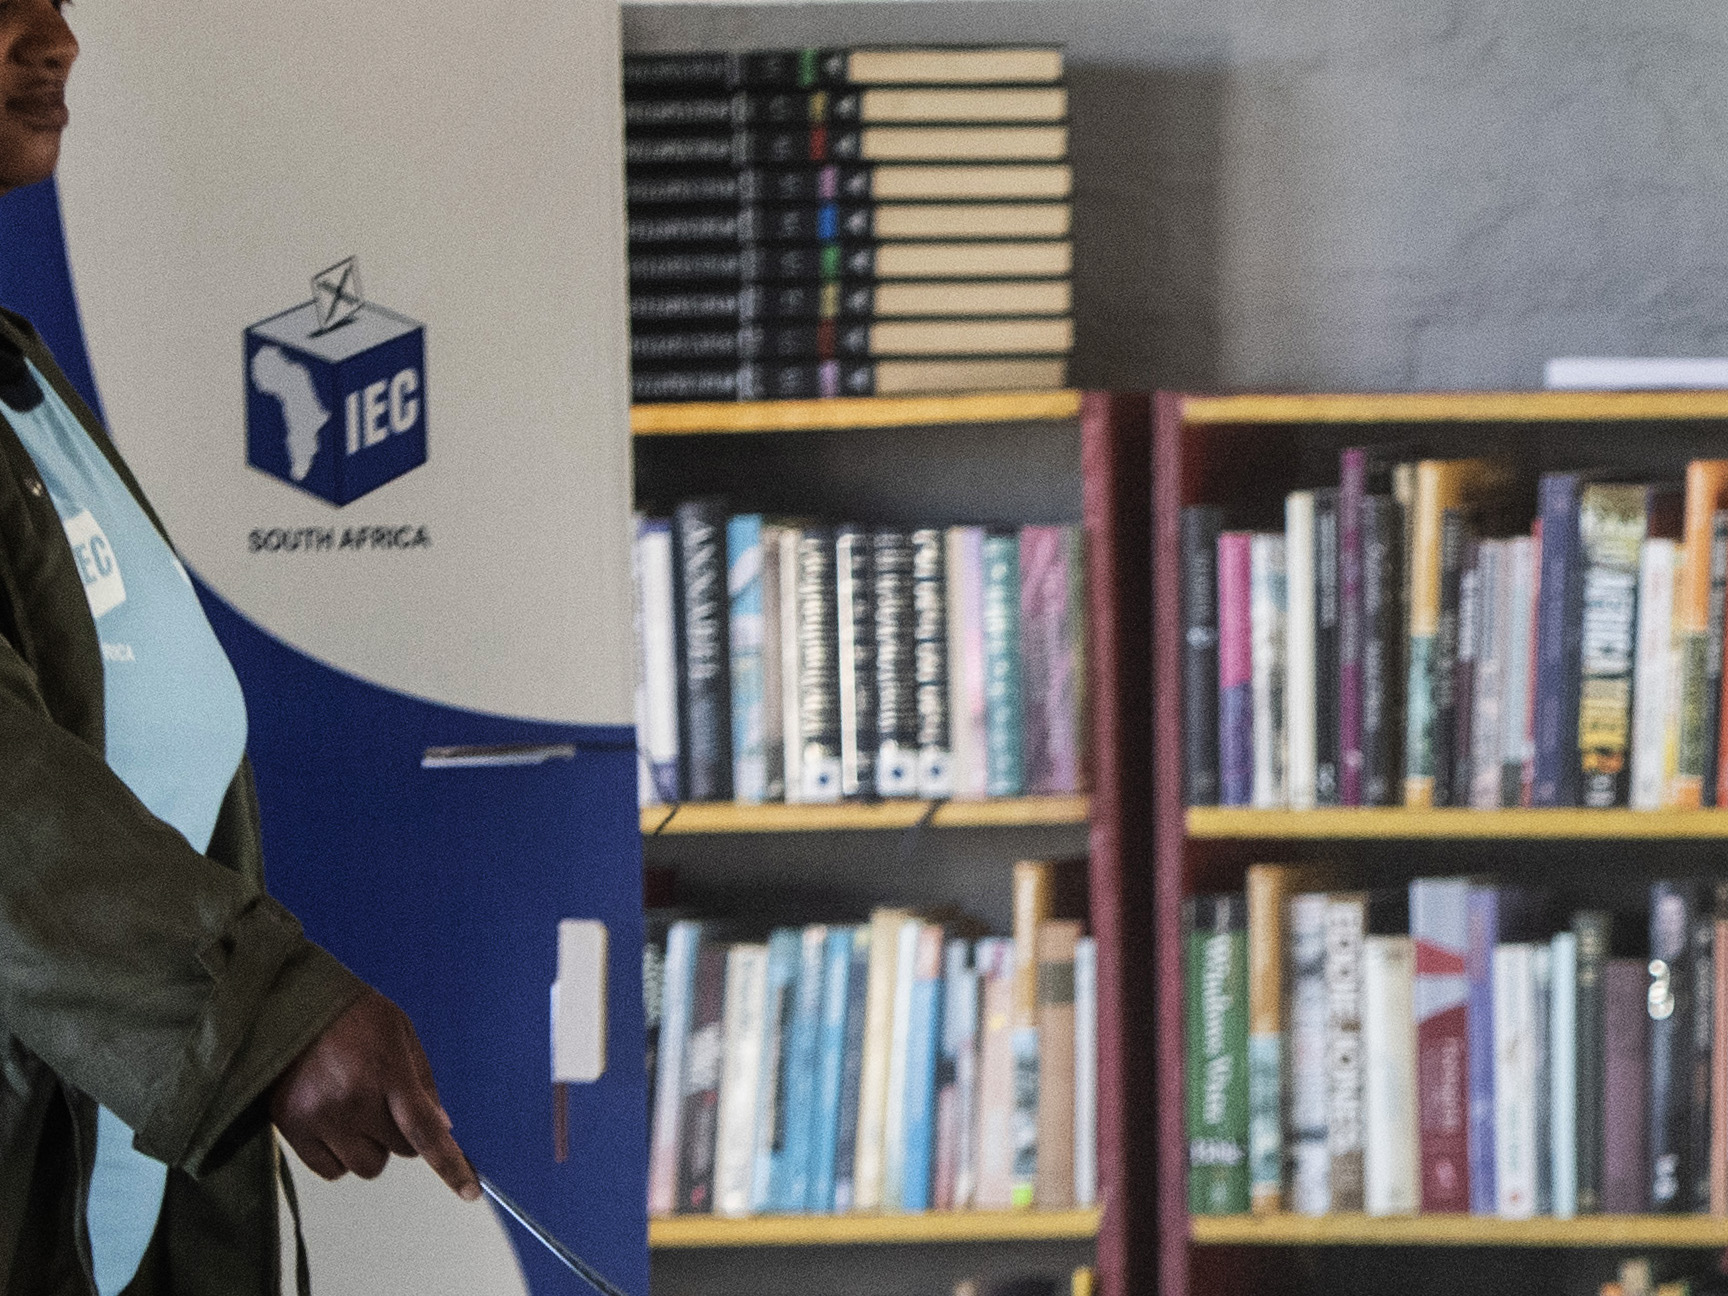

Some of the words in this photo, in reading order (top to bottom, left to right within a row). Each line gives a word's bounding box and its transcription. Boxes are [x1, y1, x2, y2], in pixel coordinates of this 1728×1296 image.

[345, 367, 420, 456] IEC
[73, 534, 113, 586] EC
[248, 526, 334, 553] SOUTH
[339, 524, 431, 550] AFRICA
